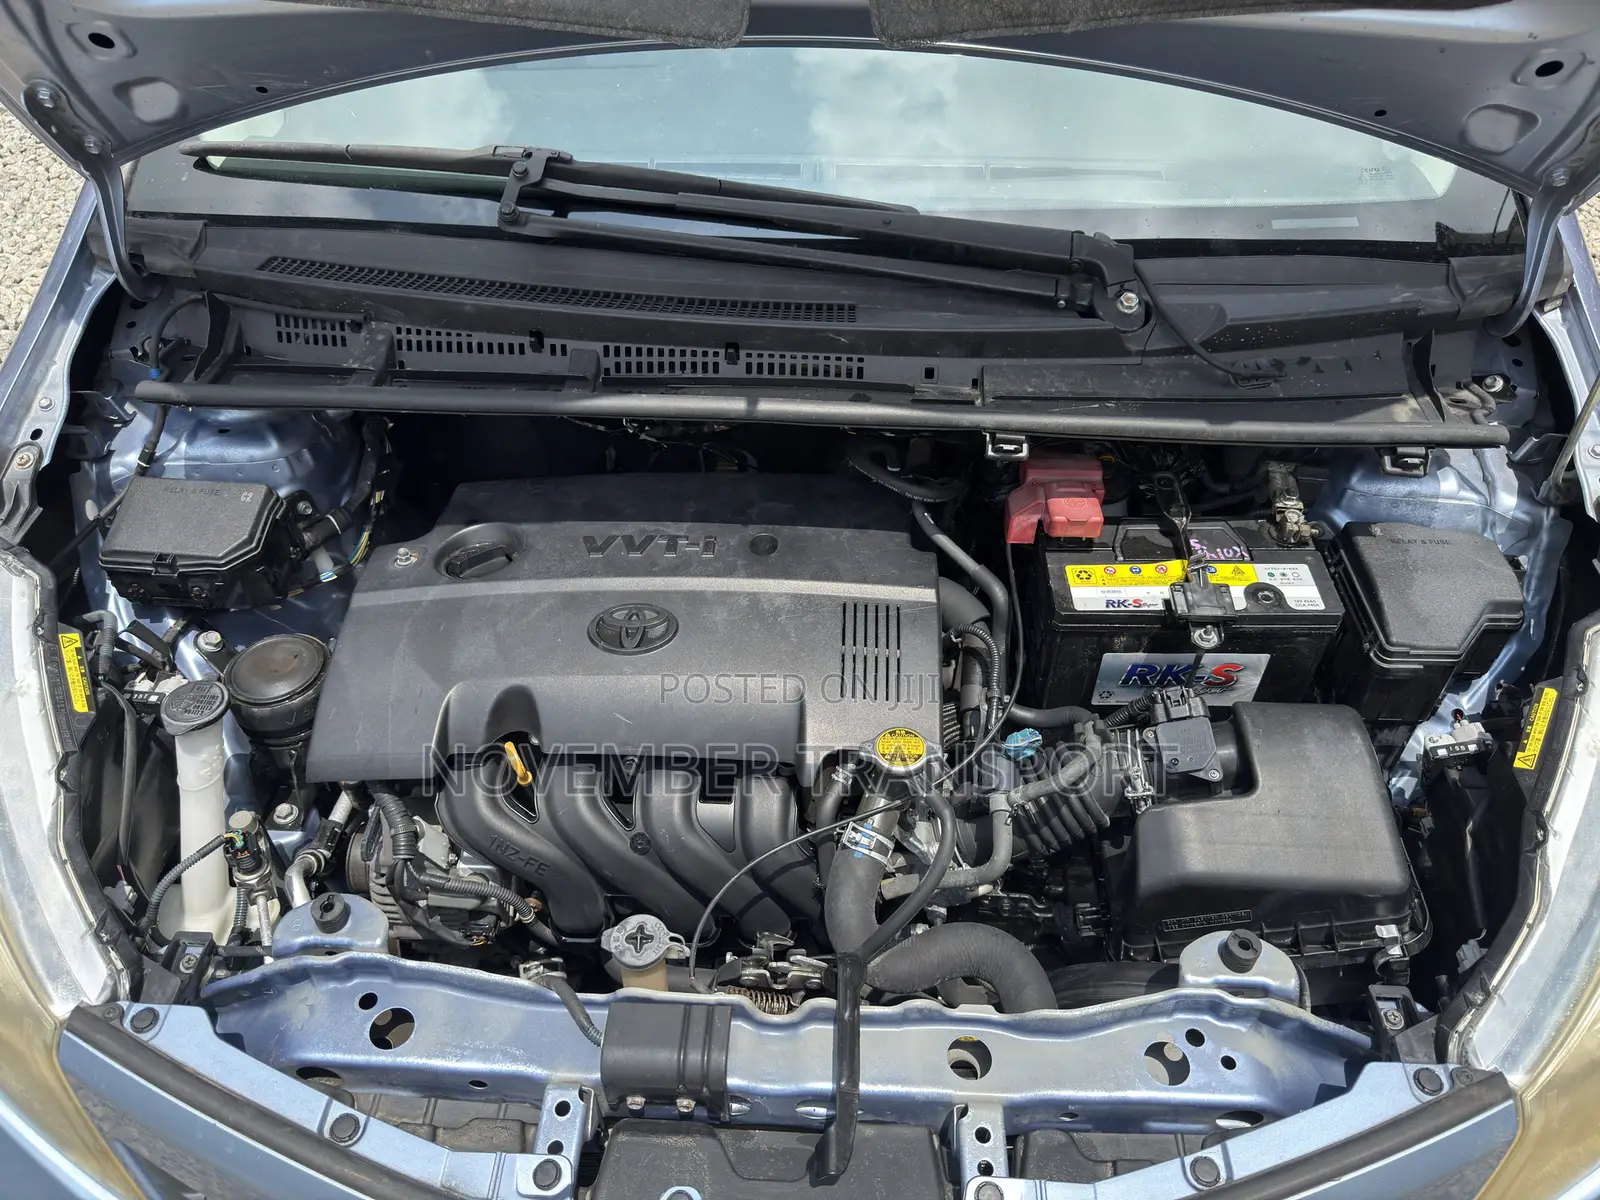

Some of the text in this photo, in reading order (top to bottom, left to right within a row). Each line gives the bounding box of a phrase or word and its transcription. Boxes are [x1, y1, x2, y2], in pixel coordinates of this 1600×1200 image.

[163, 486, 190, 494] RELAY
[581, 534, 717, 557] VVT-i
[1105, 598, 1142, 609] RK-S
[1119, 662, 1244, 688] RK-S
[488, 834, 551, 877] 1NZ-FE
